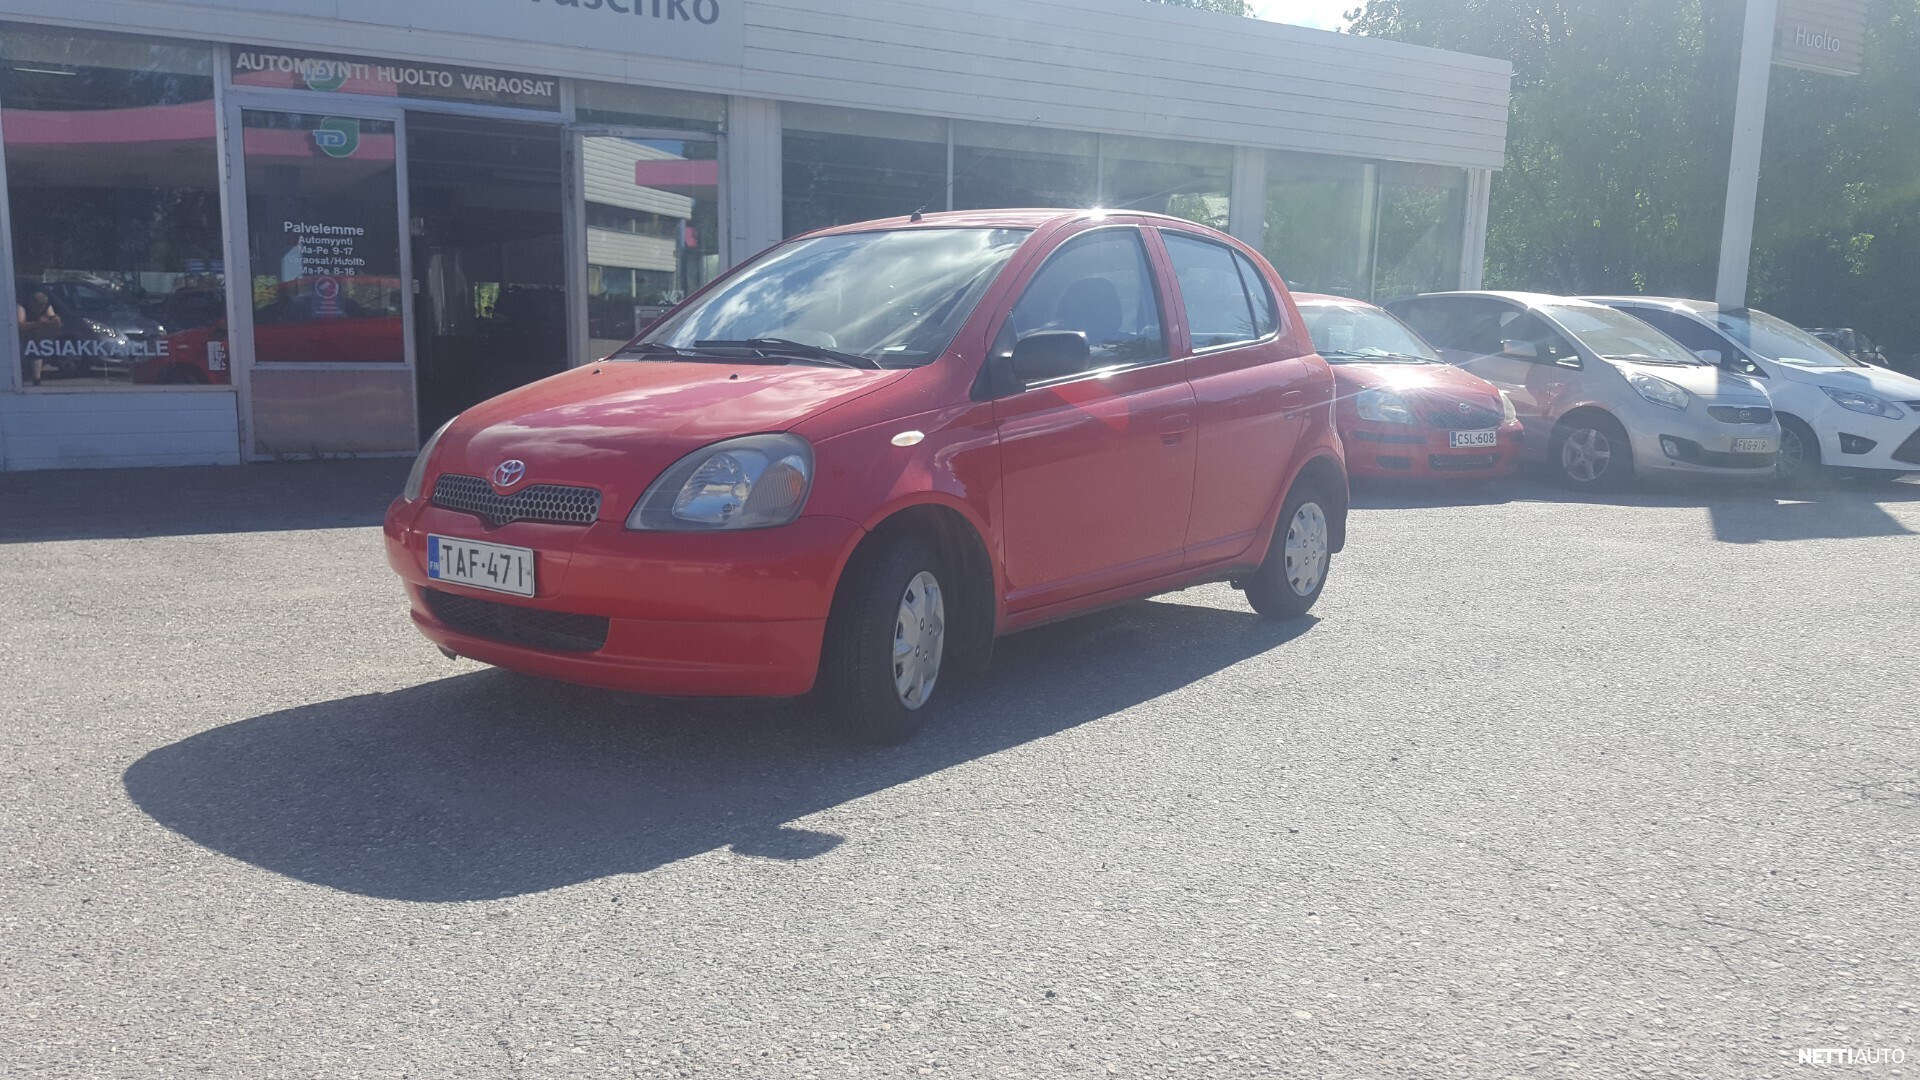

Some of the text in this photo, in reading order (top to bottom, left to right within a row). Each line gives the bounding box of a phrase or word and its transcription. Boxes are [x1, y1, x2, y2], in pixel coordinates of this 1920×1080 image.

[1796, 25, 1840, 52] Huolto
[236, 53, 369, 80] AUTOMYYNTI
[377, 65, 453, 88] HUOLTO
[461, 73, 555, 97] VARAOSAT
[284, 221, 364, 236] Palvelemme
[299, 235, 353, 246] Automyynti
[300, 246, 353, 256] Ma-Pe 9-17
[300, 266, 355, 276] Ma-Pe 8-16
[25, 340, 170, 356] ASIAKKAILLE
[1457, 432, 1494, 445] CSL-608
[442, 544, 523, 587] TAF-471
